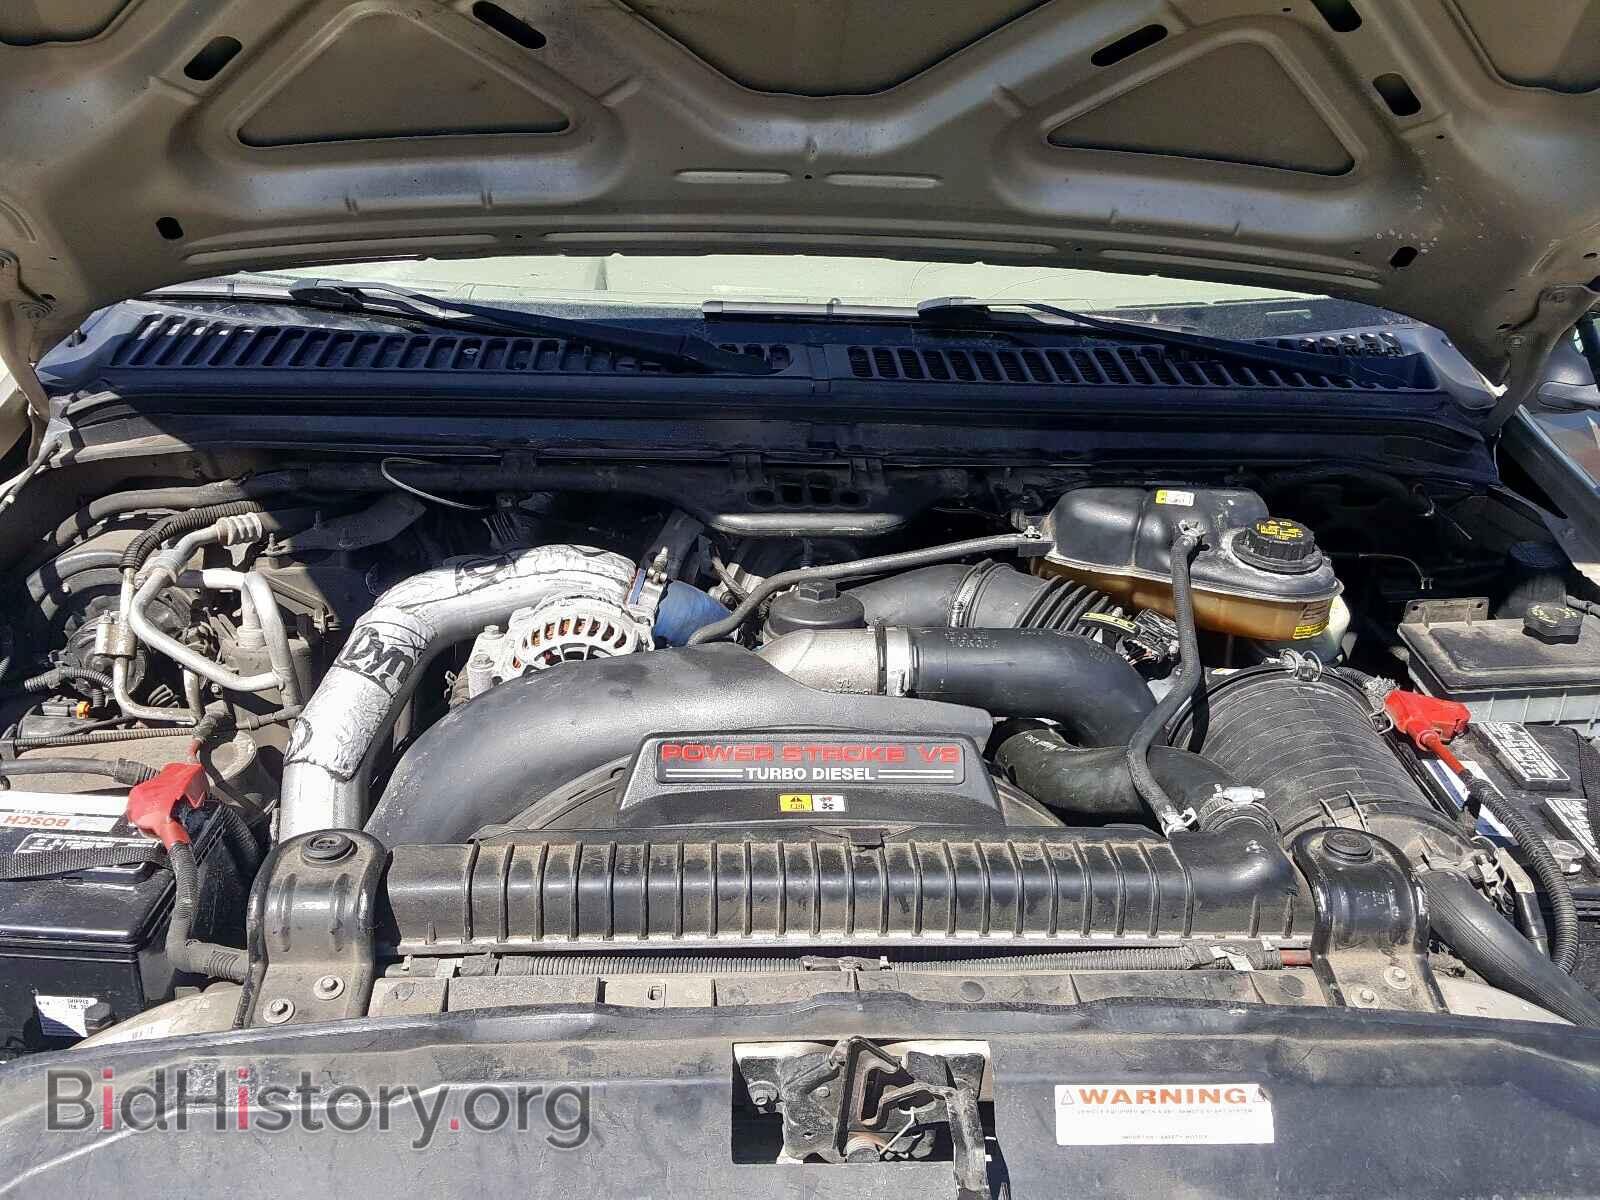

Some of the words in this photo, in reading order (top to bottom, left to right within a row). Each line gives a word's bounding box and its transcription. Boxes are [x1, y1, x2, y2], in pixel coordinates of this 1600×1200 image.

[661, 744, 773, 761] POWER
[782, 745, 905, 762] STROKE
[917, 746, 960, 762] V8
[745, 767, 805, 780] TURBO
[812, 767, 874, 780] DIESEL
[3, 815, 70, 827] BOSCH
[1078, 1087, 1247, 1105] WARNING
